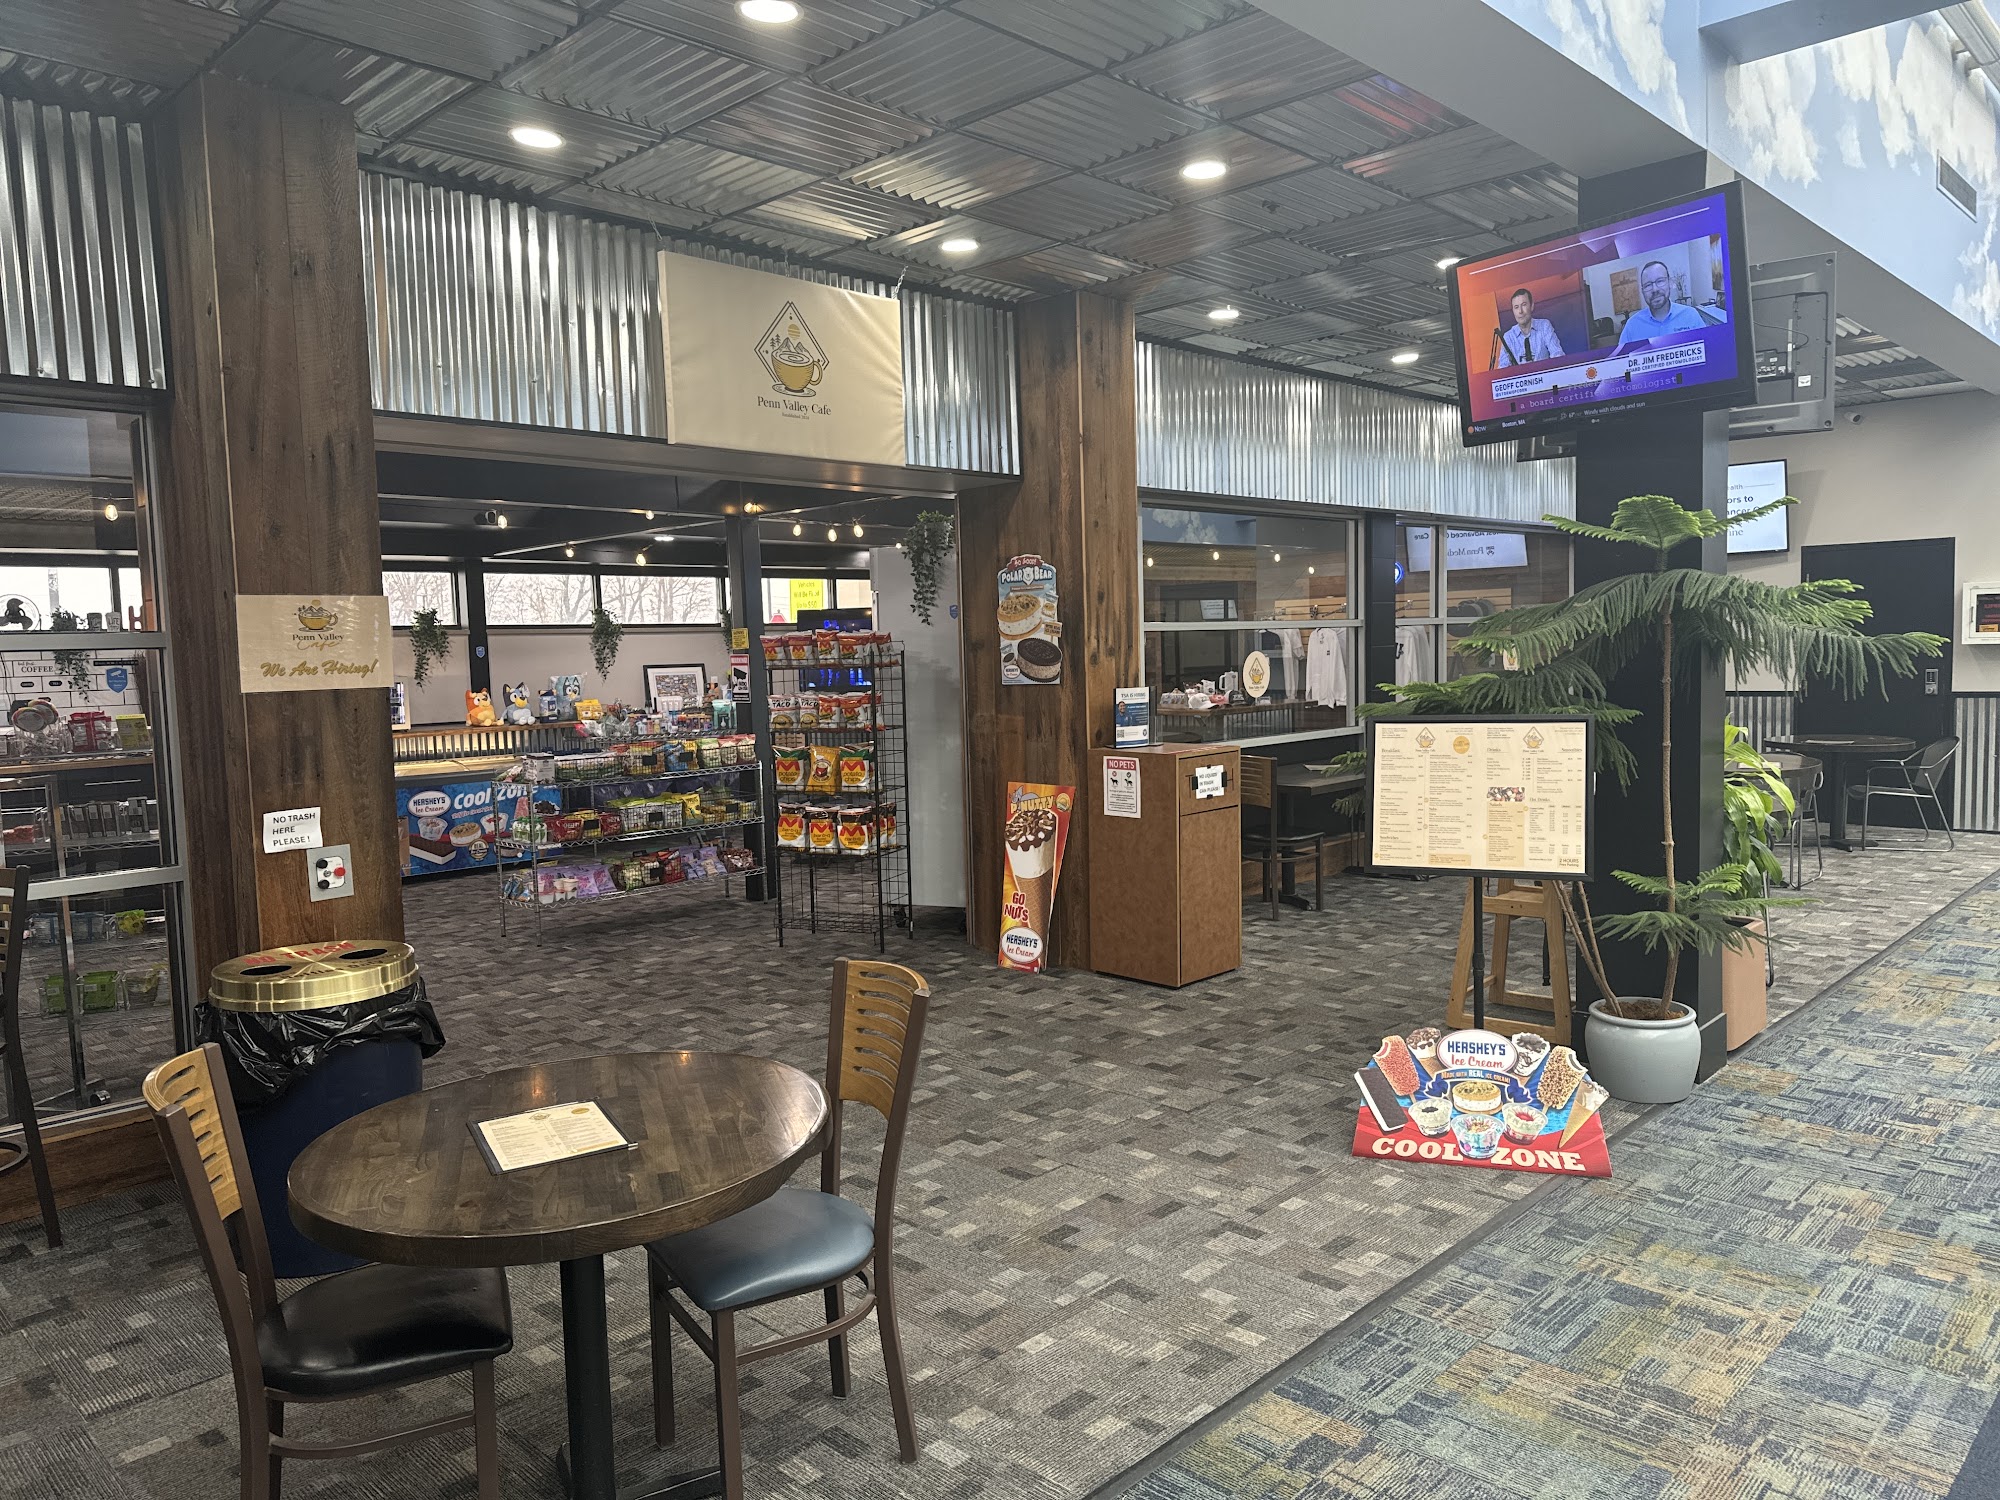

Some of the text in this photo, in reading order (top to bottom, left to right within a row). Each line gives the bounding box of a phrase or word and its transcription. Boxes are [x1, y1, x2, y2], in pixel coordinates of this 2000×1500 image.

[1628, 346, 1702, 368] DR. JIM FREDERICKS
[1494, 376, 1544, 392] GEOFF CORNISH
[1530, 397, 1555, 408] board
[1610, 376, 1678, 394] entomologist
[757, 396, 832, 416] Penn Valley Cafe
[1610, 404, 1626, 412] clouds
[1002, 566, 1052, 583] POLAR BEAR
[318, 633, 345, 642] Valley
[260, 658, 378, 678] We Are Hiring!
[1120, 761, 1135, 769] PETS
[413, 796, 446, 806] HERSHEY'S
[453, 788, 492, 810] Cool
[273, 813, 316, 824] NO TRASH
[272, 826, 295, 835] HERE
[273, 836, 306, 846] PLEASE
[1012, 893, 1025, 905] GO
[1004, 904, 1029, 922] NUTS
[1006, 934, 1038, 948] HERSHEY'S
[243, 941, 356, 965] NO TRASH
[1015, 947, 1035, 958] Cream
[1448, 1040, 1506, 1055] HERSHEY'S
[1452, 1054, 1504, 1068] Ice Cream
[1469, 1069, 1484, 1078] REAL
[1372, 1138, 1586, 1171] COOL ZONE
